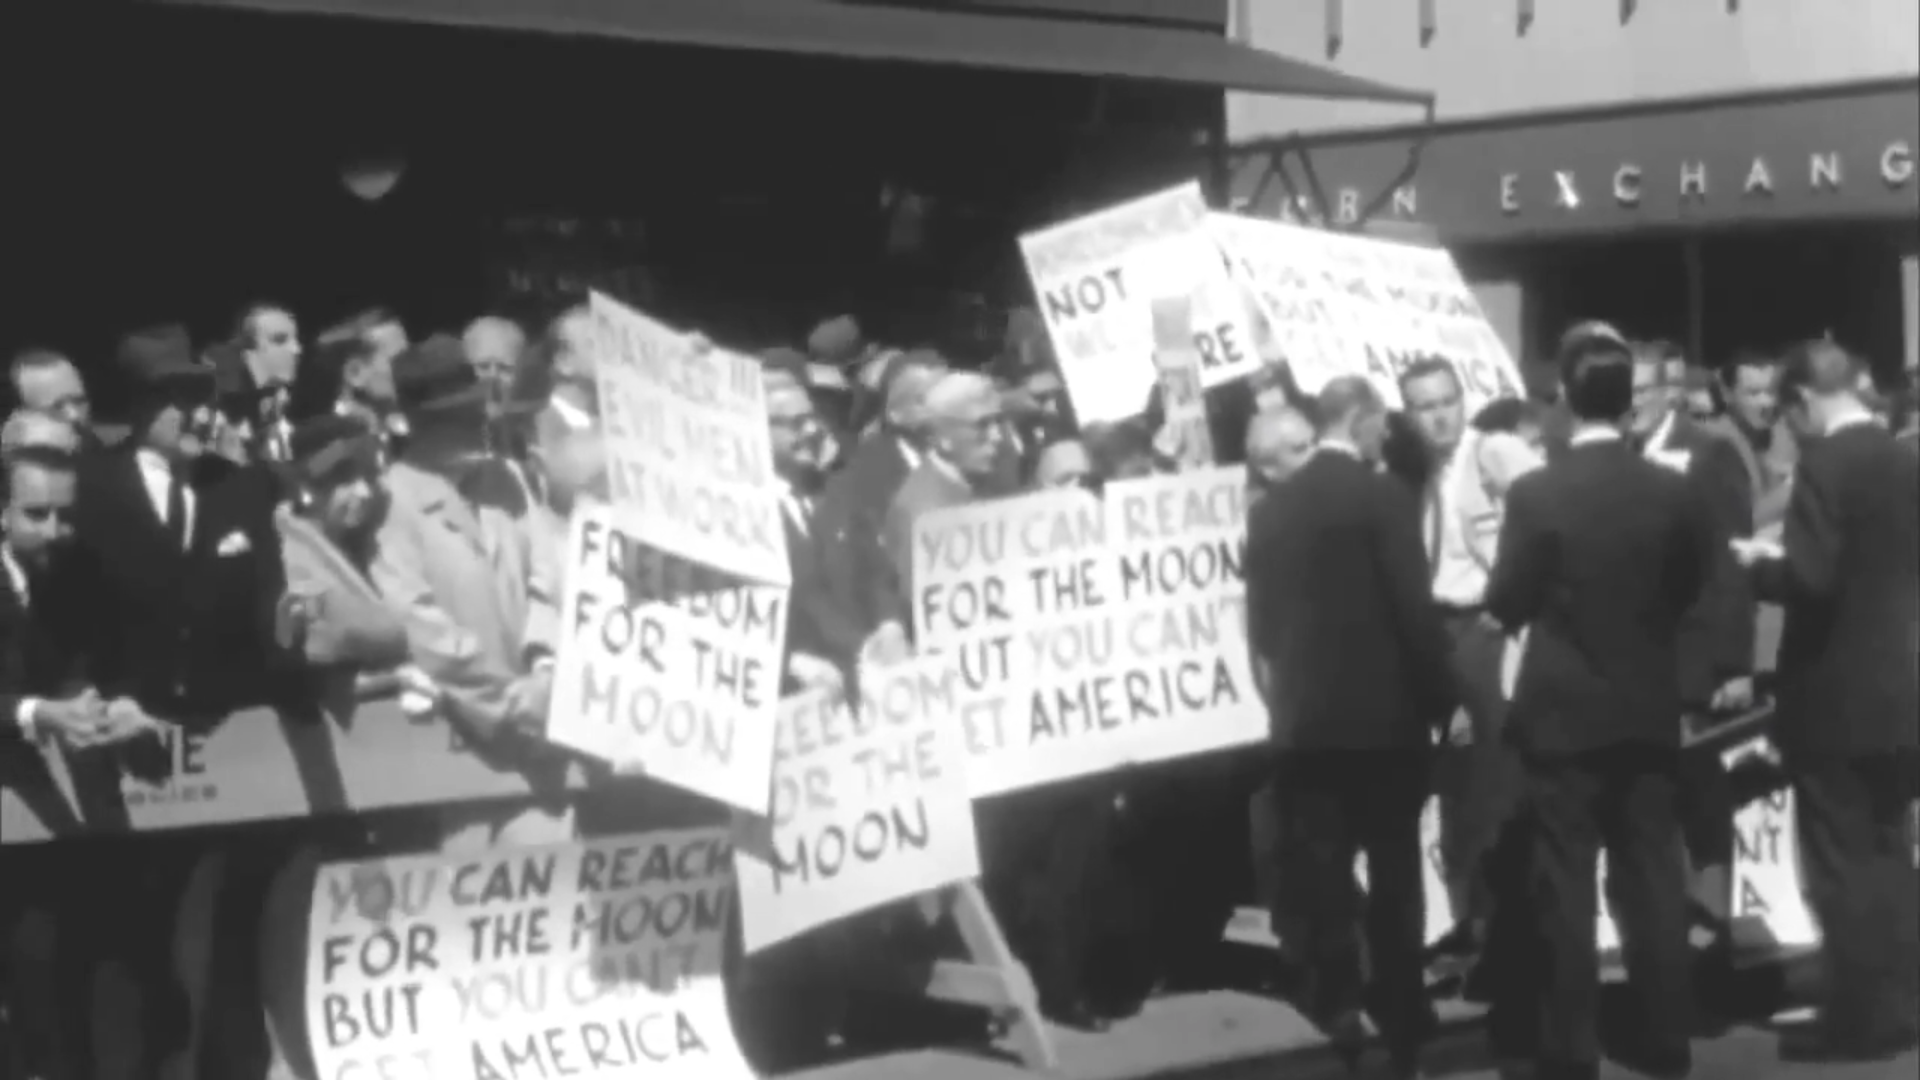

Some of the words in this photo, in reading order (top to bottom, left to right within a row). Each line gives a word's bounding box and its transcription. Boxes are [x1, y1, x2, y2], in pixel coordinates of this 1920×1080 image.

[1044, 267, 1128, 325] NOT
[921, 519, 1006, 573] YOU
[1020, 507, 1107, 557] CAN
[922, 576, 1011, 632] FOR
[1029, 558, 1106, 613] THE
[1119, 537, 1246, 601] MOON
[575, 592, 666, 674] FOR
[691, 637, 763, 709] THE
[927, 634, 1011, 692] UT
[1027, 616, 1113, 672] YOU
[581, 661, 735, 767] MOON
[960, 698, 1006, 755] ET
[1028, 655, 1240, 745] AMERICA
[776, 764, 838, 828] OR
[852, 729, 943, 796] THE
[328, 867, 438, 926] YOU
[449, 852, 558, 906] CAN
[577, 838, 736, 894] REACH
[771, 797, 930, 896] MOON
[322, 922, 440, 986] FOR
[467, 904, 552, 964] THE
[571, 884, 730, 952] MOON
[322, 982, 424, 1049] BUT
[451, 962, 549, 1024] YOU
[471, 1009, 709, 1080] AMERICA
